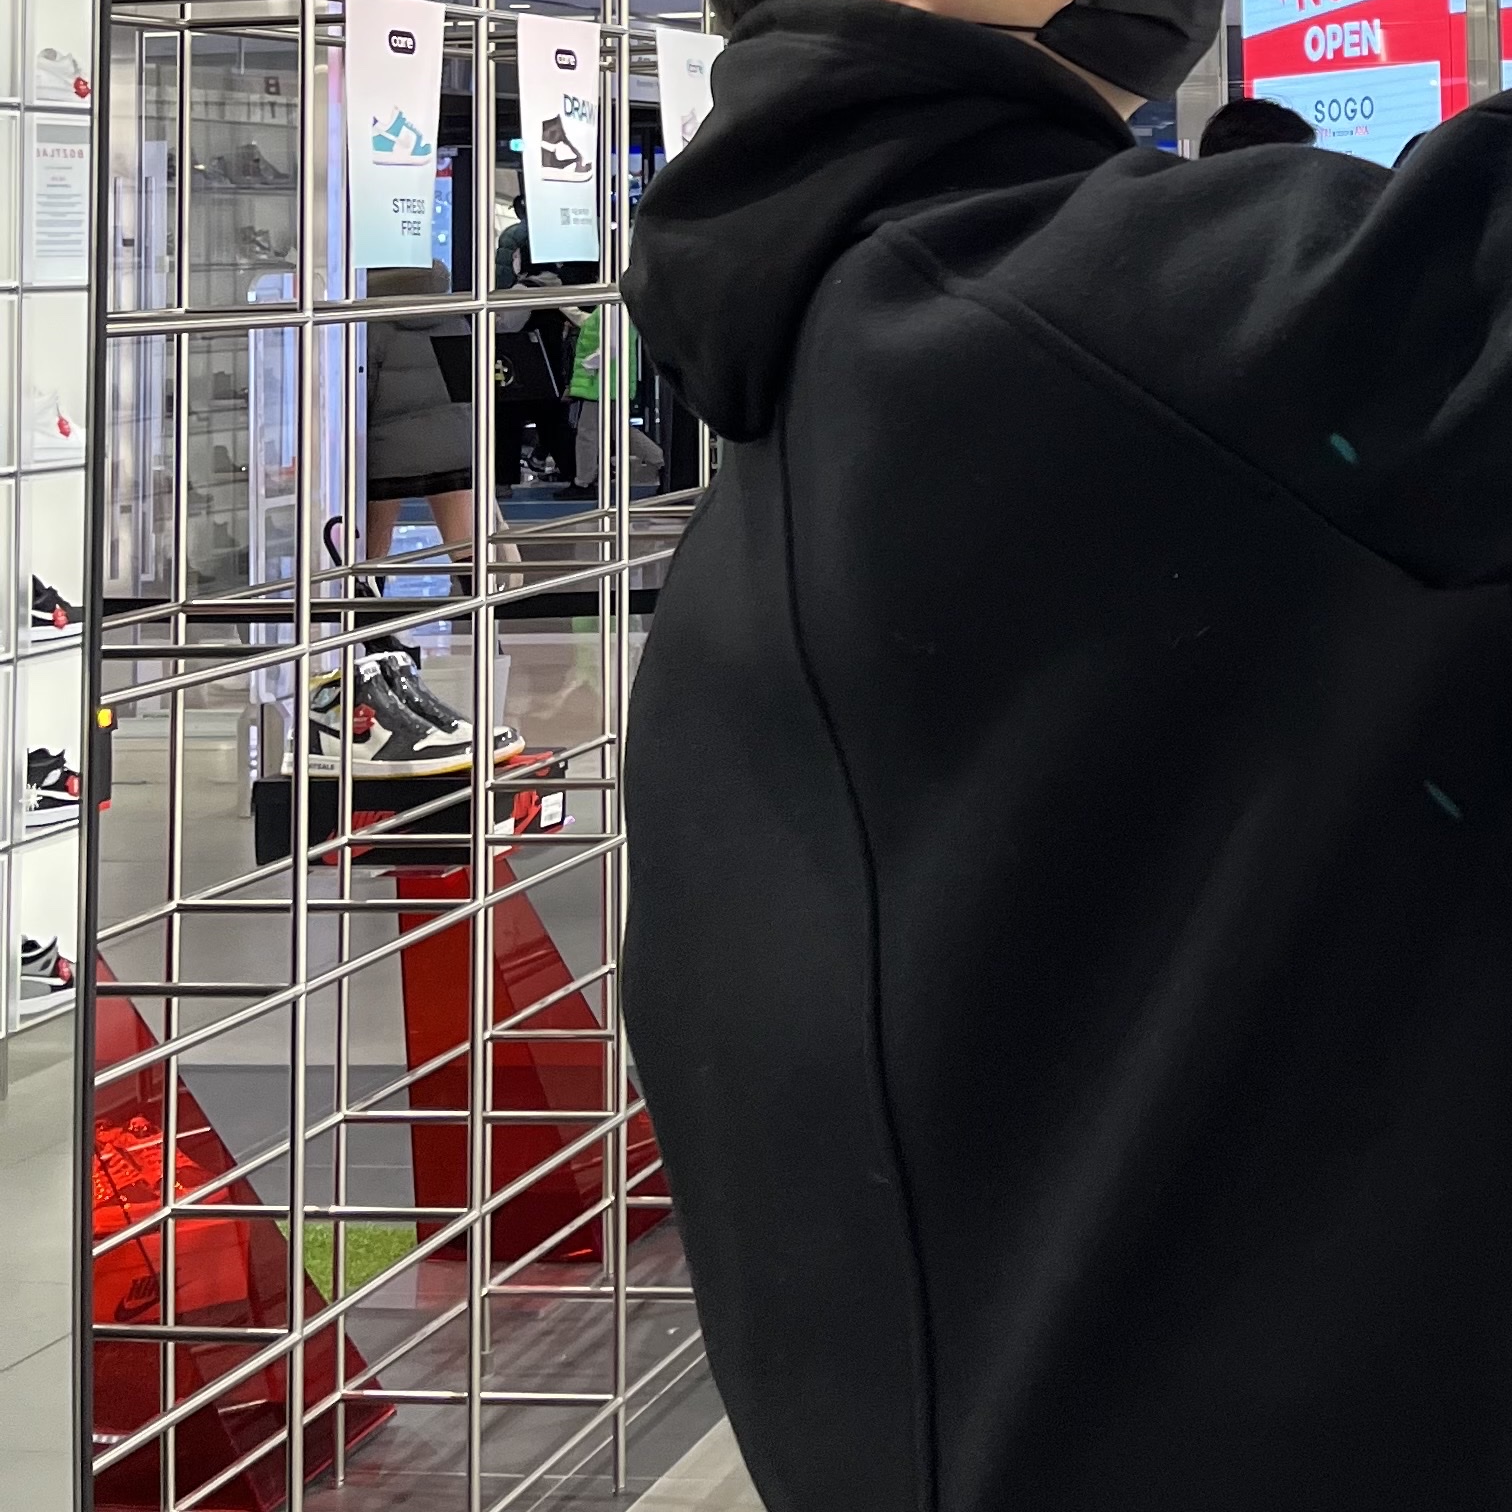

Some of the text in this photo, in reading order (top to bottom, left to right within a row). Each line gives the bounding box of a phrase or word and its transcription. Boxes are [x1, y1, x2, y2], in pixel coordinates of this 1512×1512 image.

[1304, 18, 1381, 63] OPEN
[1314, 95, 1374, 123] SOGO
[392, 198, 425, 214] STRESS
[401, 220, 422, 237] FREE
